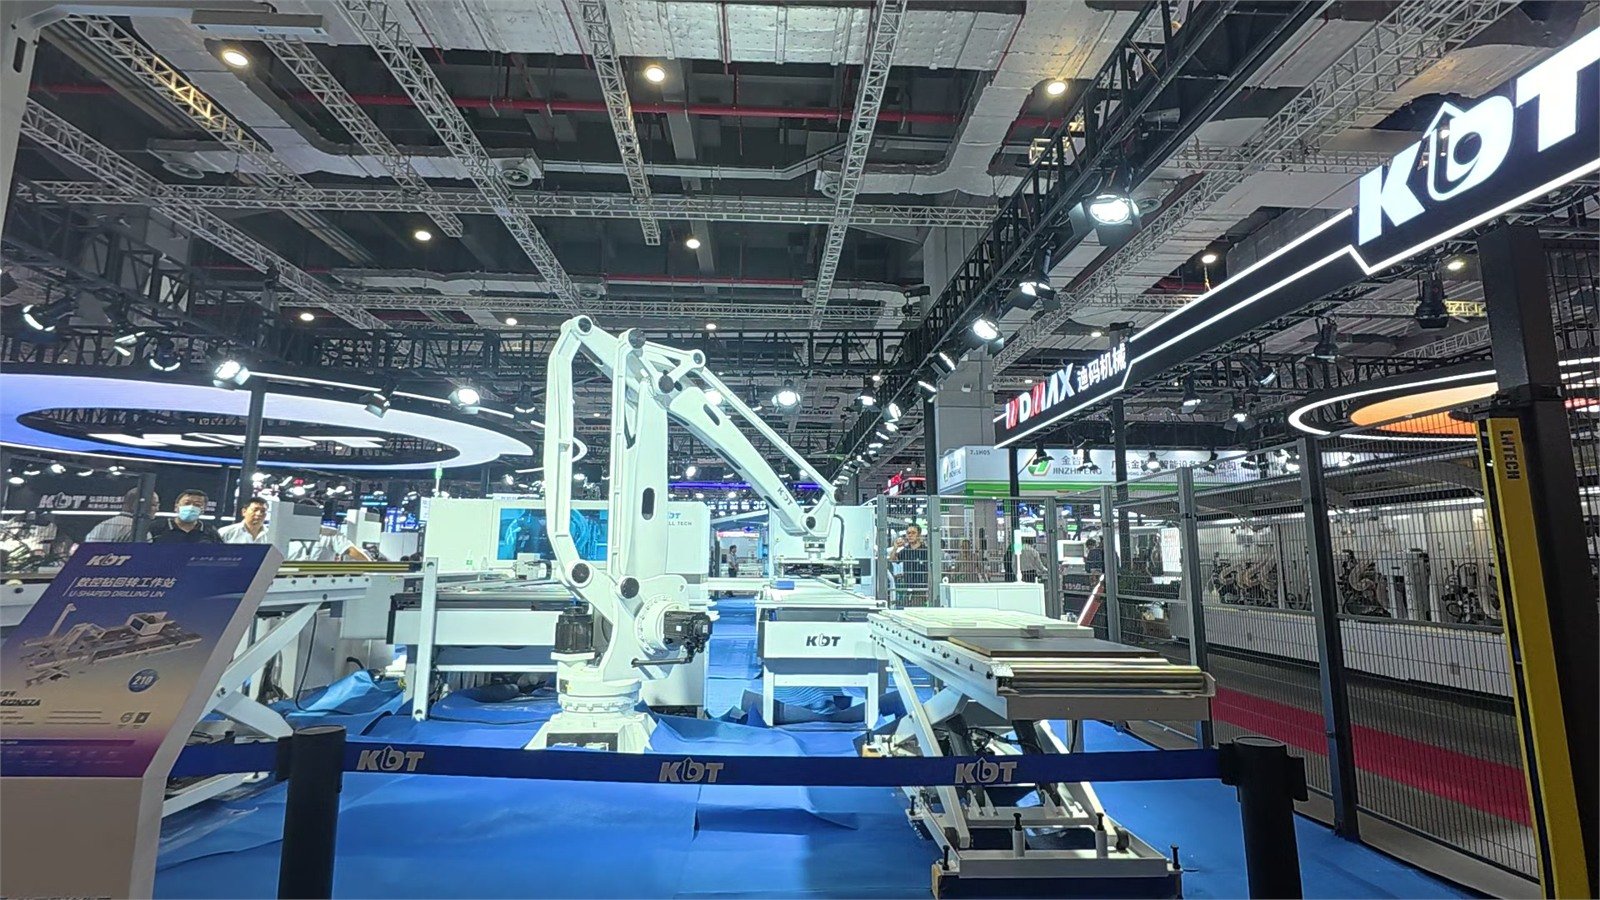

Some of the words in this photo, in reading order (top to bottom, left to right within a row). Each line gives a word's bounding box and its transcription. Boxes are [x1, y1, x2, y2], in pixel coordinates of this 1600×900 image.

[1078, 343, 1127, 392] 迪码机械
[111, 590, 149, 598] DRILLING
